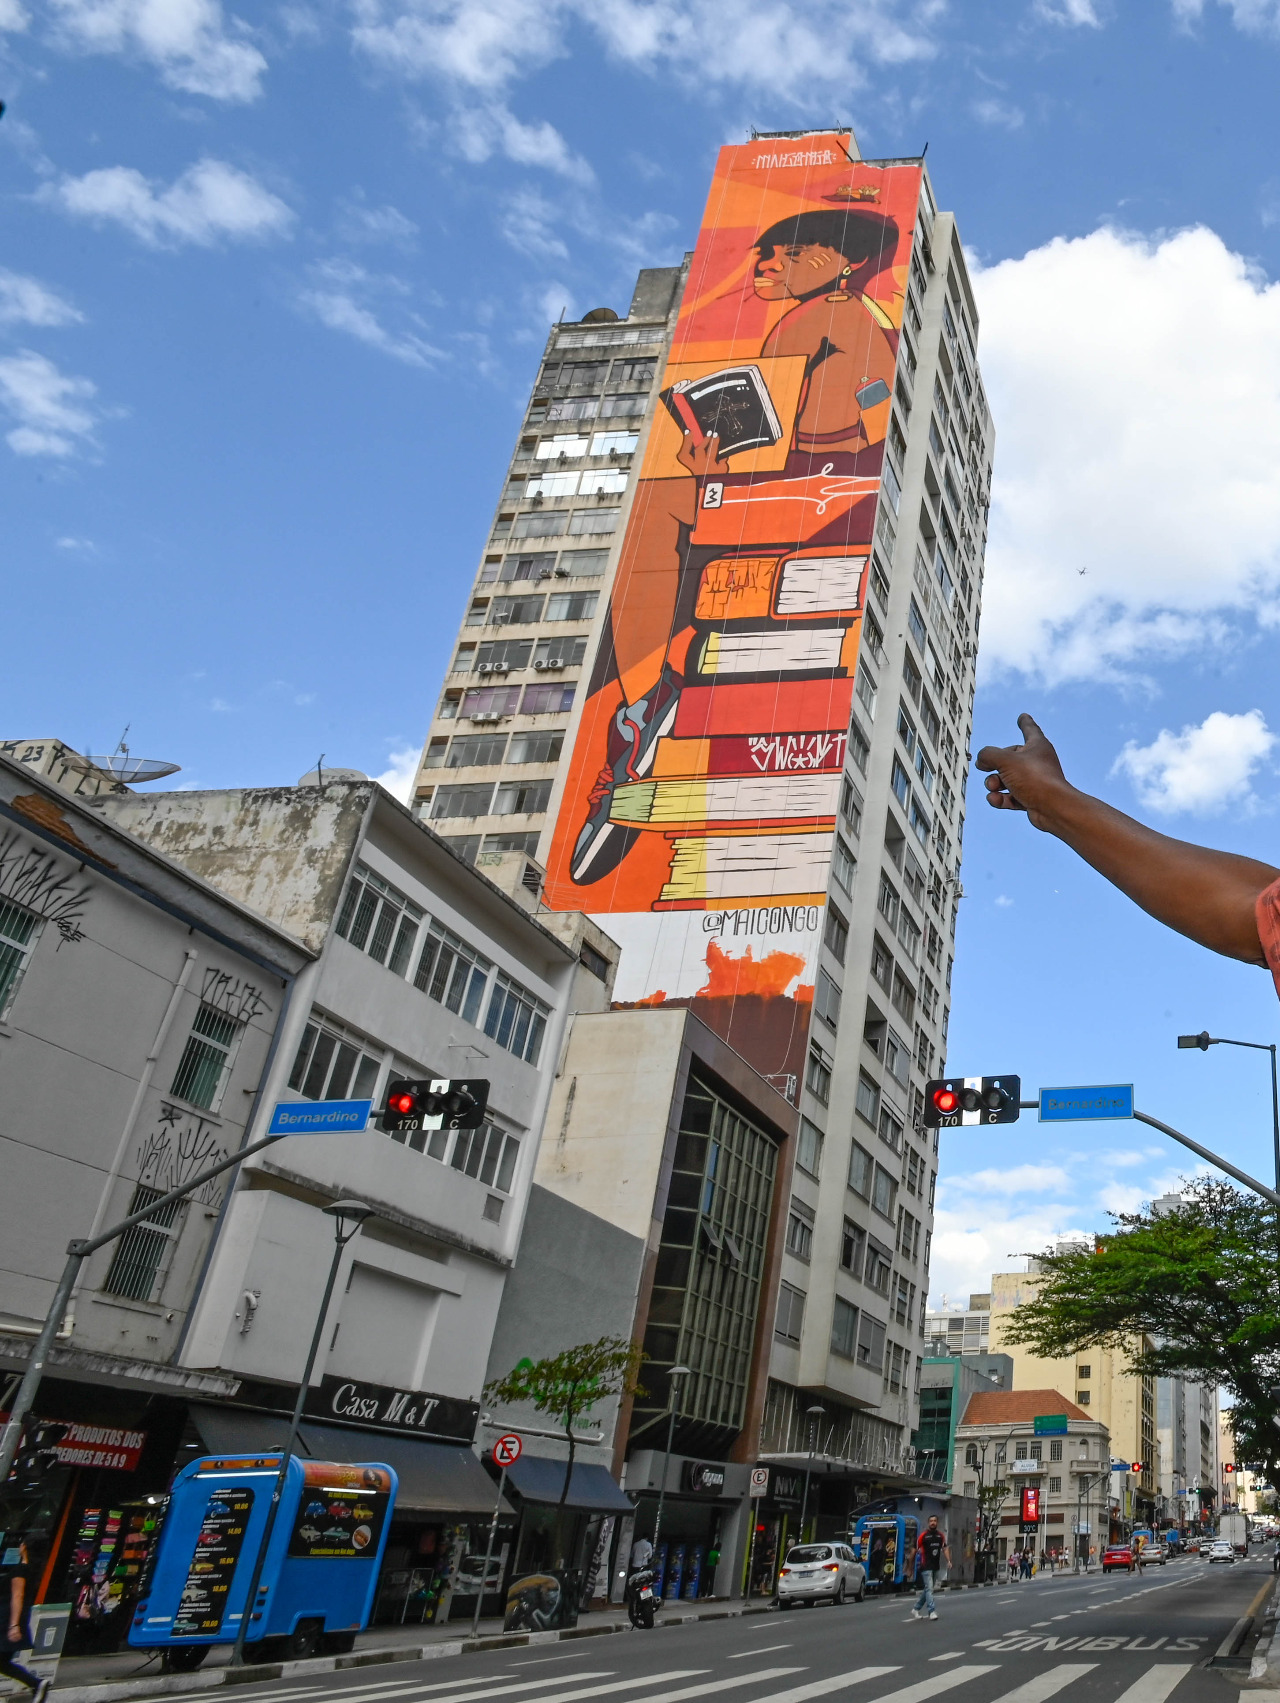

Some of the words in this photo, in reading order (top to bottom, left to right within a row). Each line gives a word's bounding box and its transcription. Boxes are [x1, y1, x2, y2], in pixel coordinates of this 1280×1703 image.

[702, 905, 819, 936] @MAICONGO
[1048, 1097, 1125, 1111] Bernardino
[278, 1111, 360, 1126] Bernardino
[397, 1119, 418, 1131] 170
[450, 1120, 459, 1129] C
[938, 1116, 958, 1127] 170
[988, 1113, 998, 1124] C
[332, 1383, 375, 1420] Casa
[381, 1391, 411, 1424] M
[405, 1408, 417, 1425] &
[418, 1398, 440, 1428] T
[68, 1425, 122, 1447] PRODUTOS
[121, 1431, 145, 1449] DOS
[93, 1452, 106, 1466] DE
[986, 1632, 1209, 1651] ÔNIBUS
